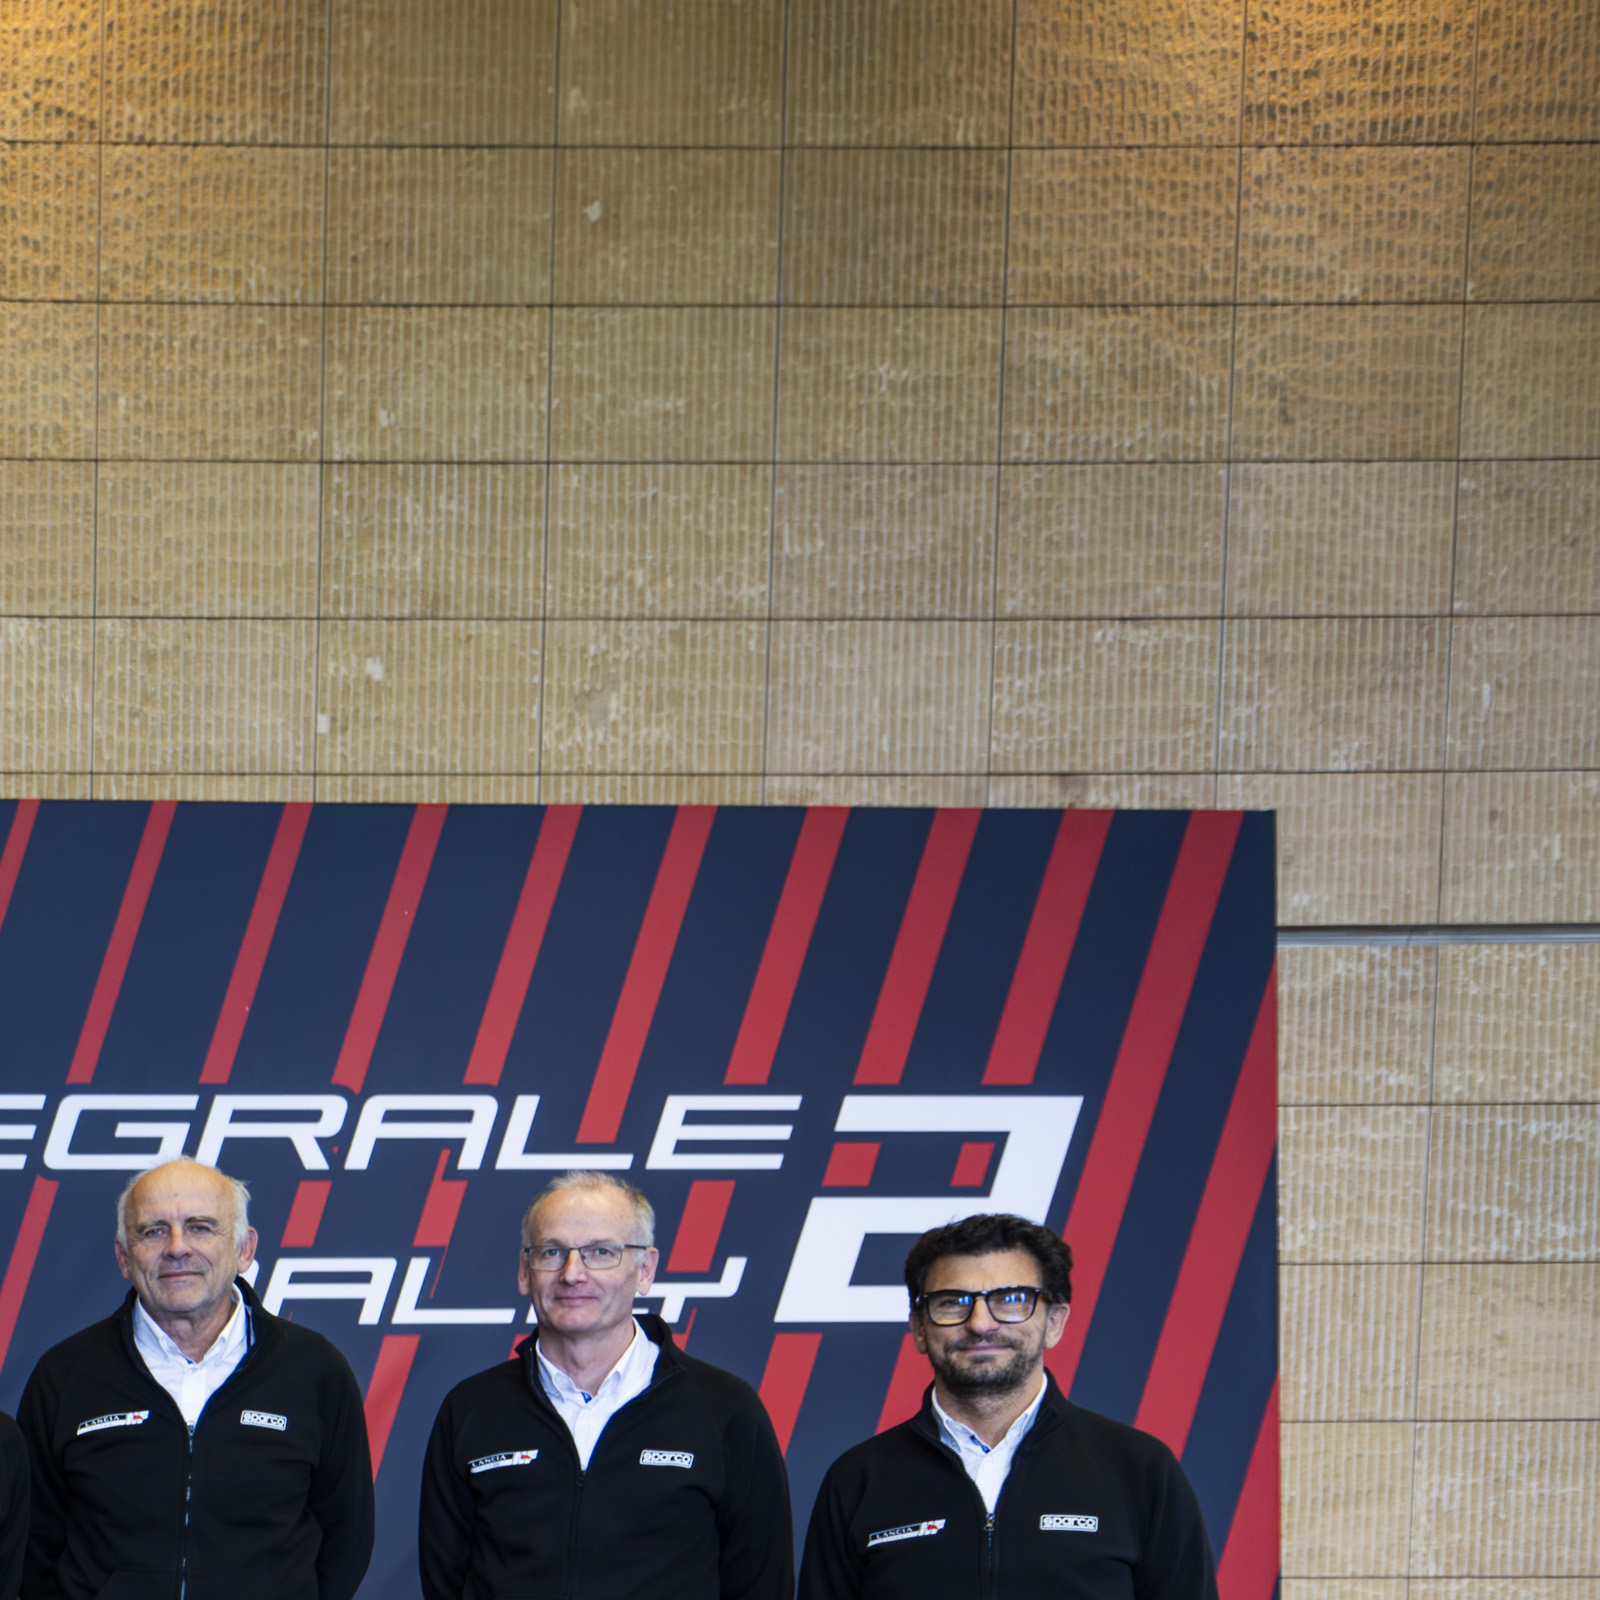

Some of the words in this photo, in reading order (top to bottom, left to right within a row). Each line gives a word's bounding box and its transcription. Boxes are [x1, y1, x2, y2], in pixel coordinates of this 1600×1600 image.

[774, 1095, 1084, 1323] 2
[242, 1411, 284, 1427] sparco
[642, 1451, 690, 1466] sparco
[1042, 1515, 1096, 1529] sparco
[876, 1527, 912, 1539] LANCIA
